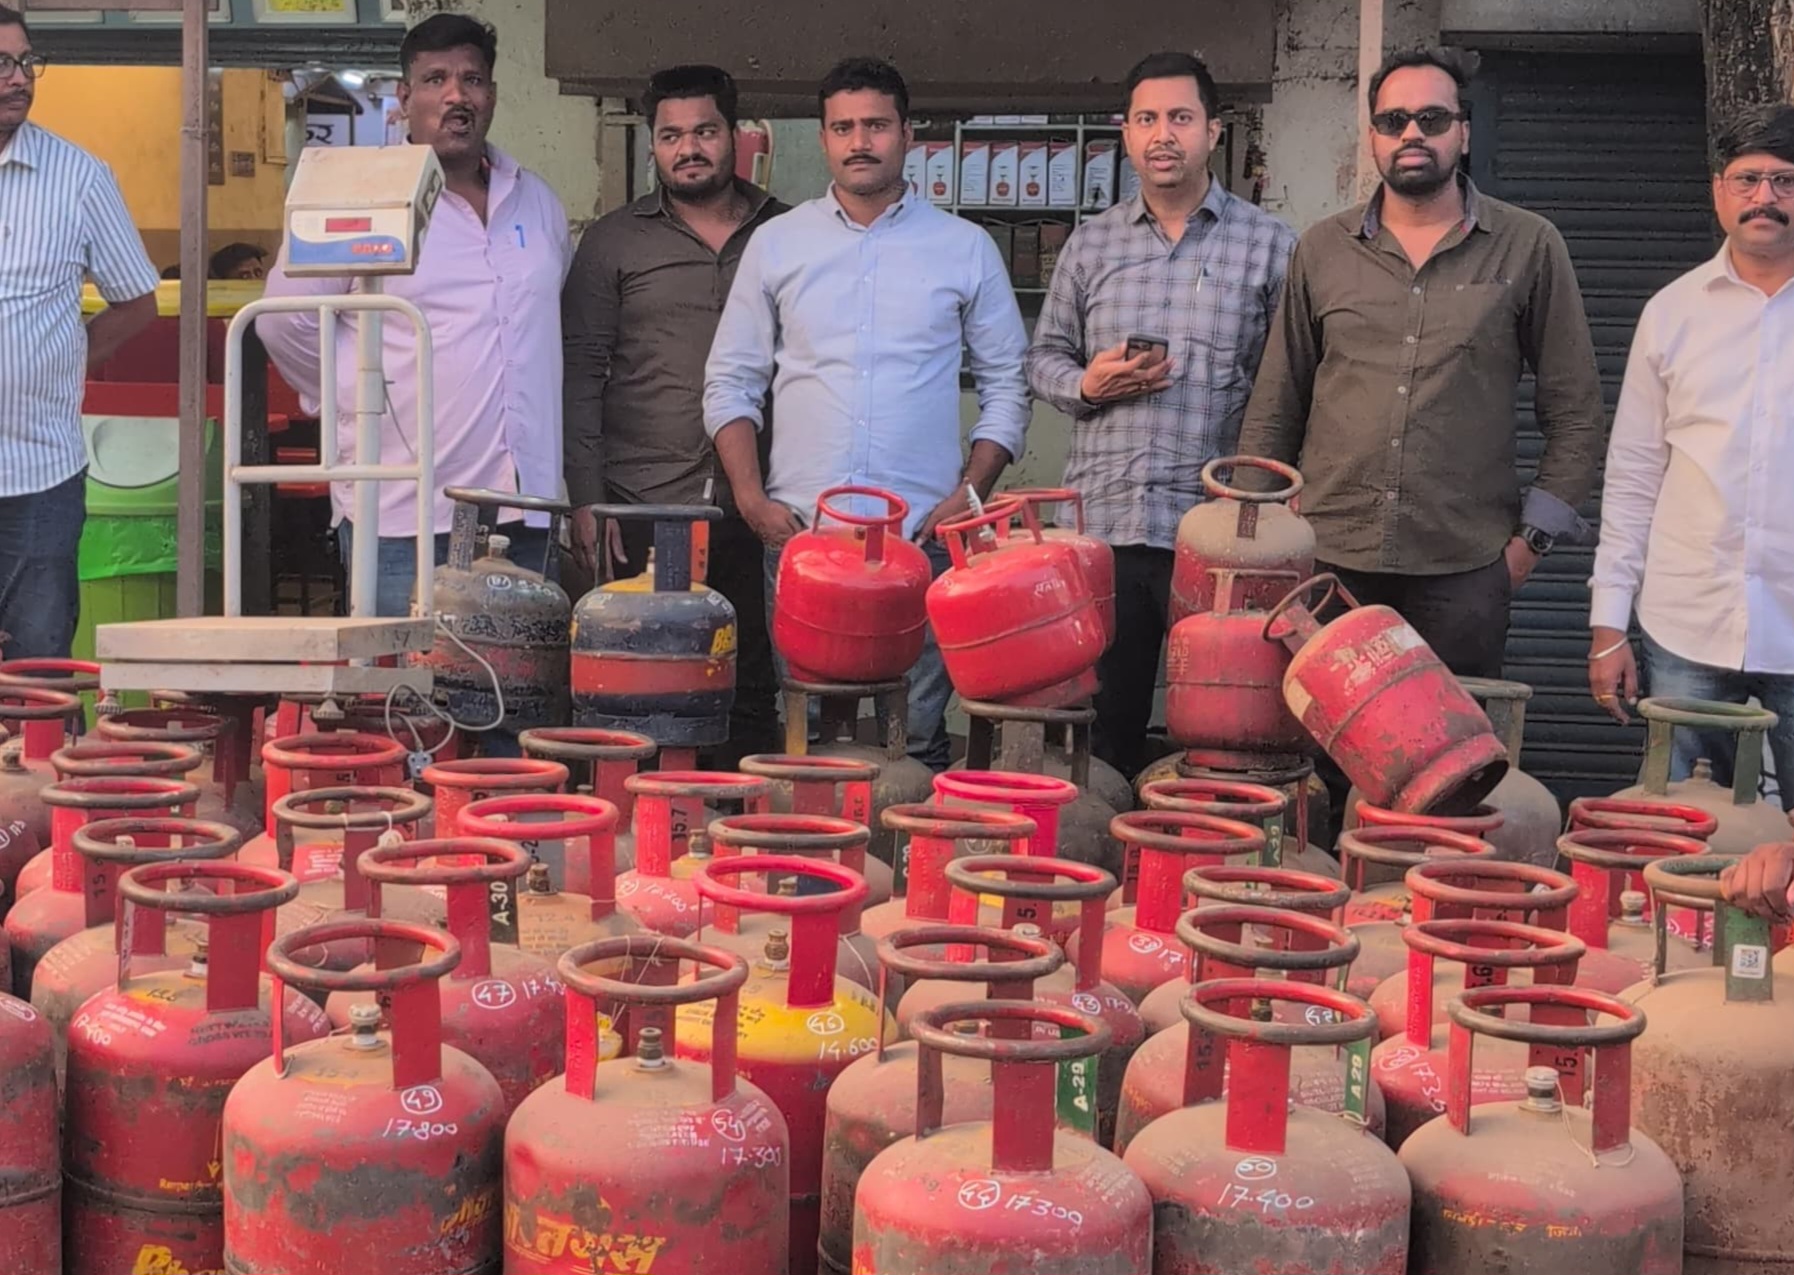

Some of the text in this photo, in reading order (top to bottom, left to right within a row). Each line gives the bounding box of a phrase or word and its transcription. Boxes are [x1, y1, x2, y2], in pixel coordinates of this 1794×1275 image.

[489, 881, 510, 927] A-30
[475, 982, 513, 1005] 47
[404, 1087, 438, 1110] 49
[1072, 1062, 1089, 1112] A-29
[1217, 1183, 1314, 1213] 17.400
